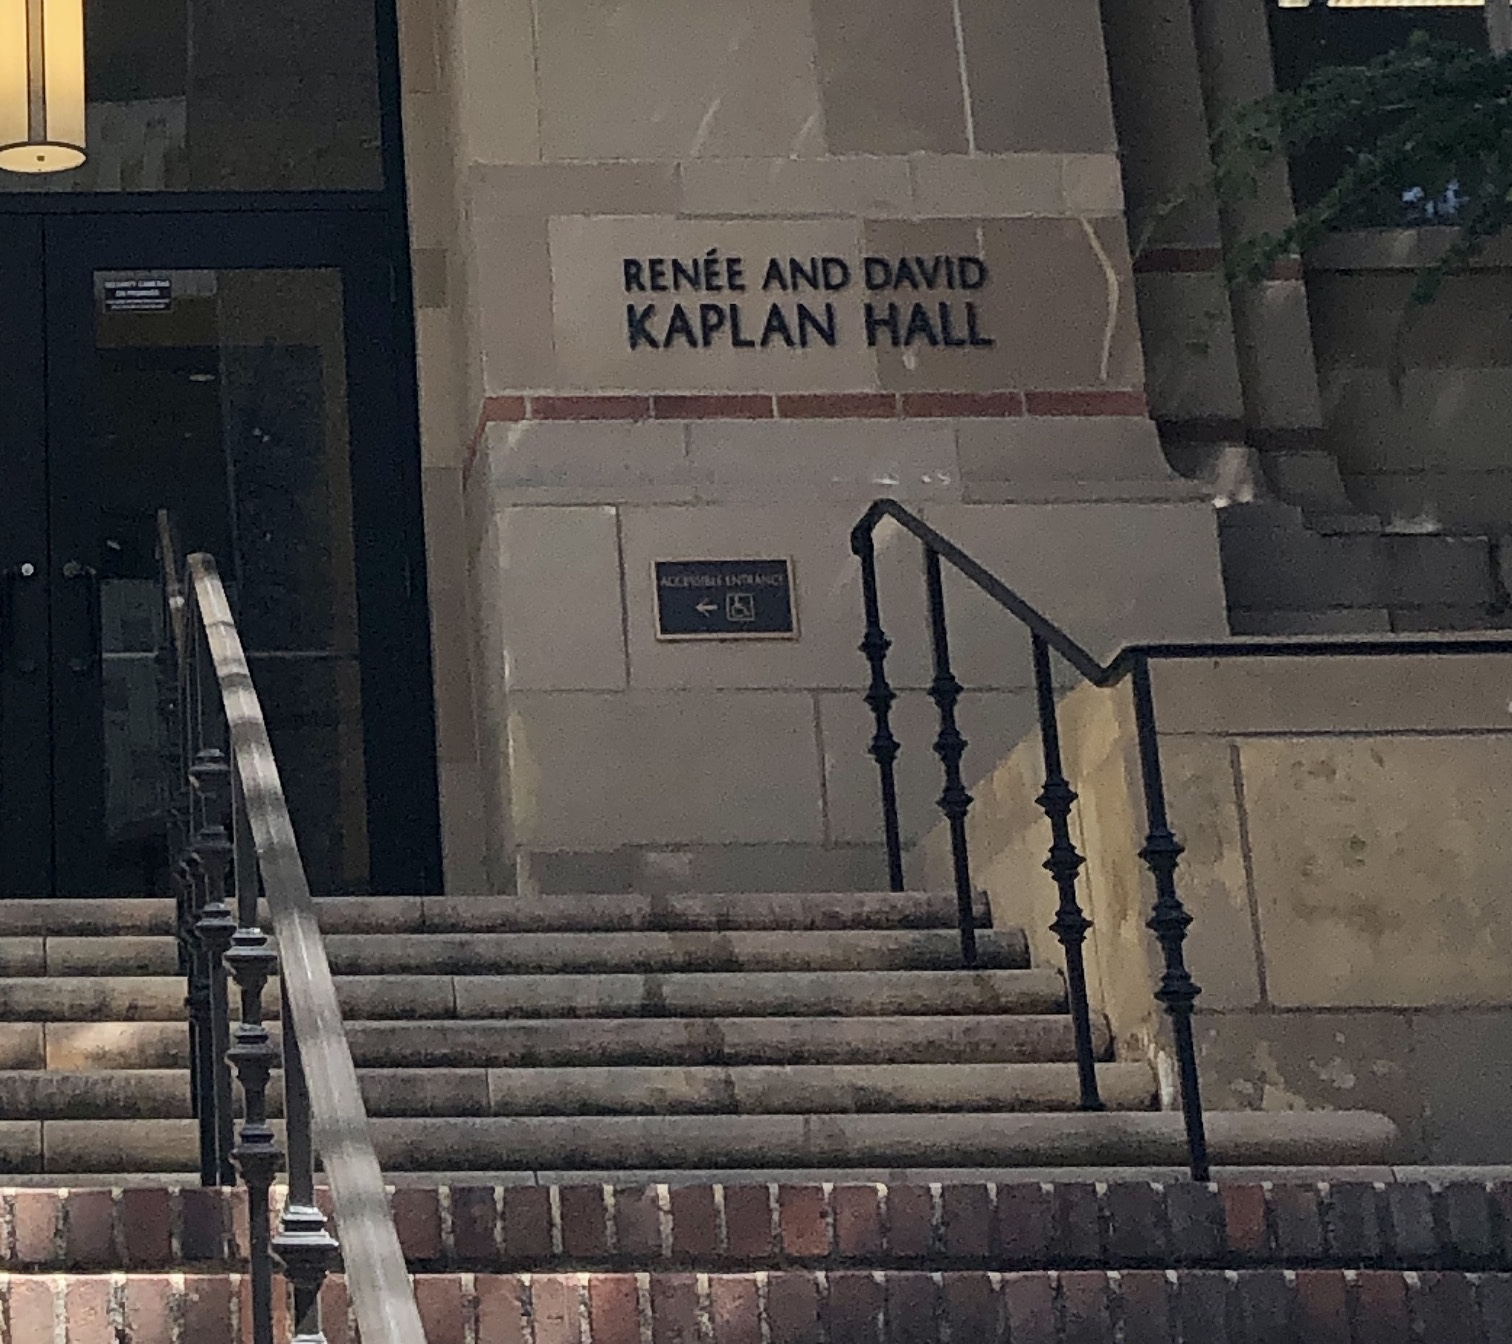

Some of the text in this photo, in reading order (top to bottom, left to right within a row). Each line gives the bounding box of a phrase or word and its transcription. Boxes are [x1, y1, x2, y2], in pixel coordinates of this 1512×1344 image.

[622, 248, 988, 293] RENÉE AND DAVID
[626, 301, 996, 350] KAPLAN HALL
